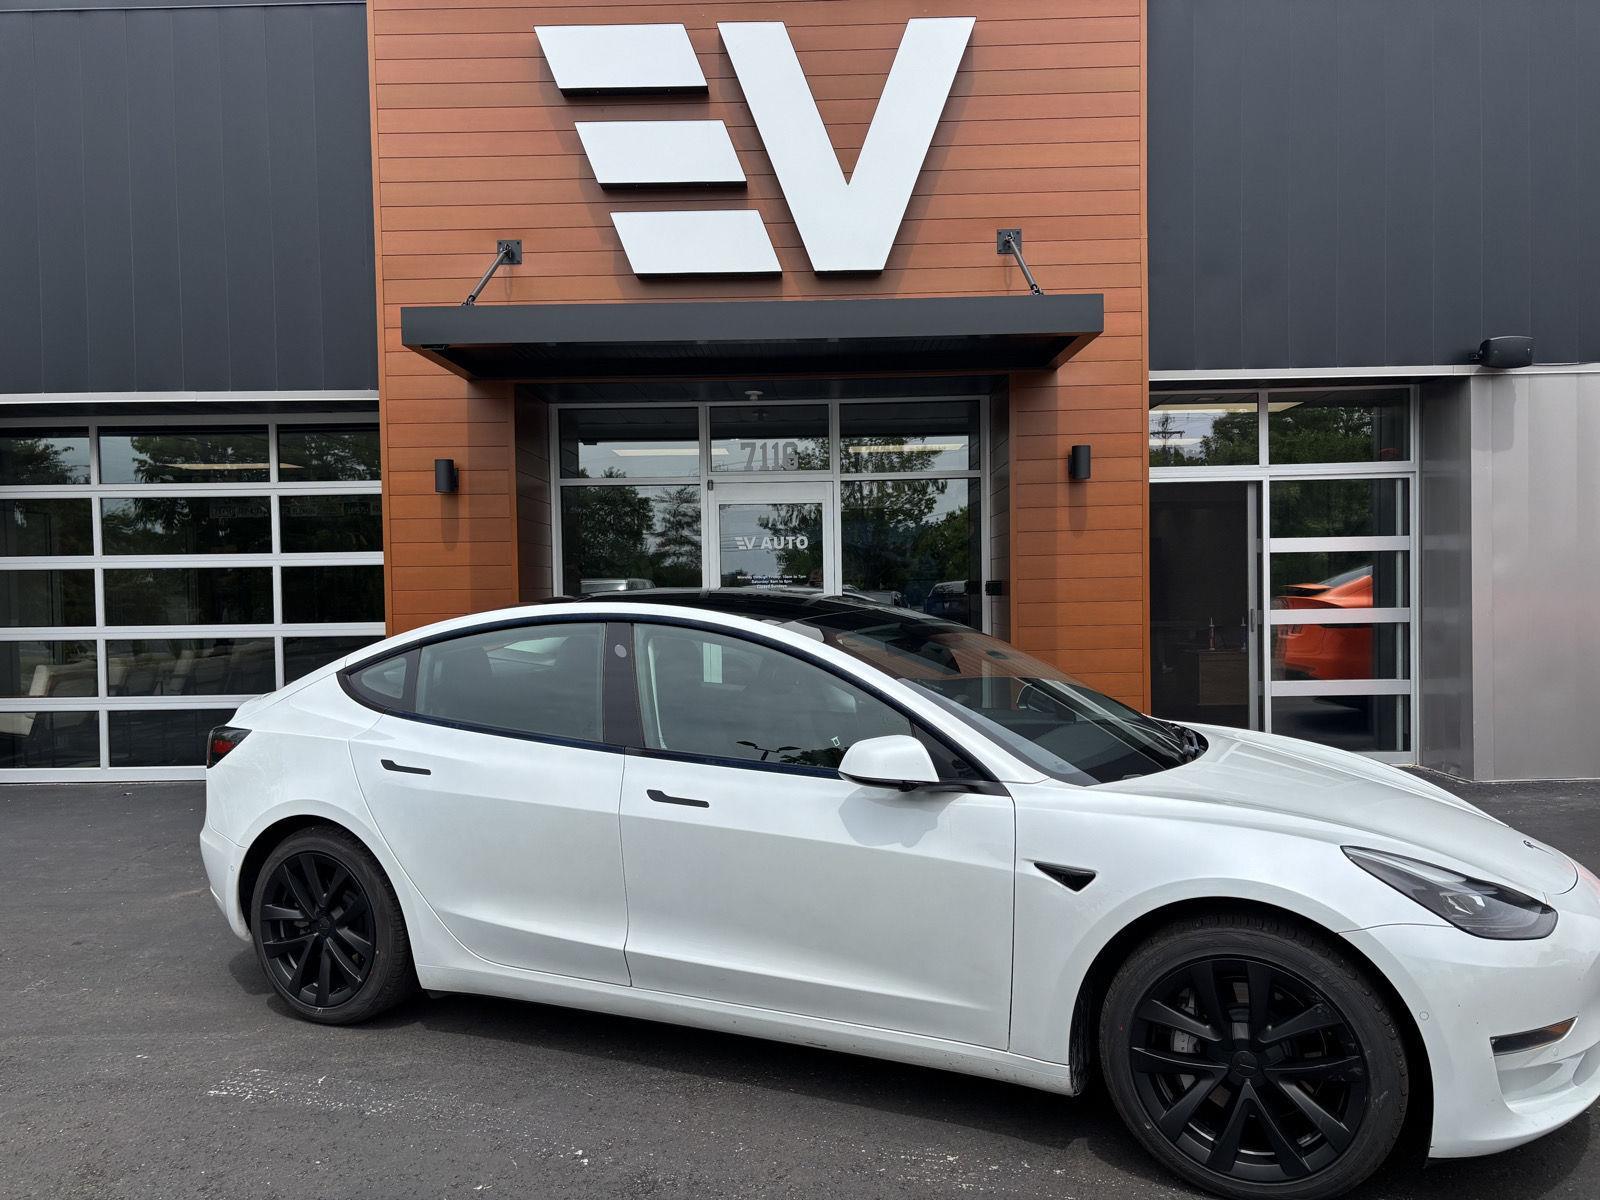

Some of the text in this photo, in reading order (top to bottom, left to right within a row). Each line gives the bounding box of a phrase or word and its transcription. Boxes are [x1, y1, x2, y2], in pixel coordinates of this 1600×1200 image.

[534, 17, 977, 272] EV
[735, 536, 809, 550] EV AUTO
